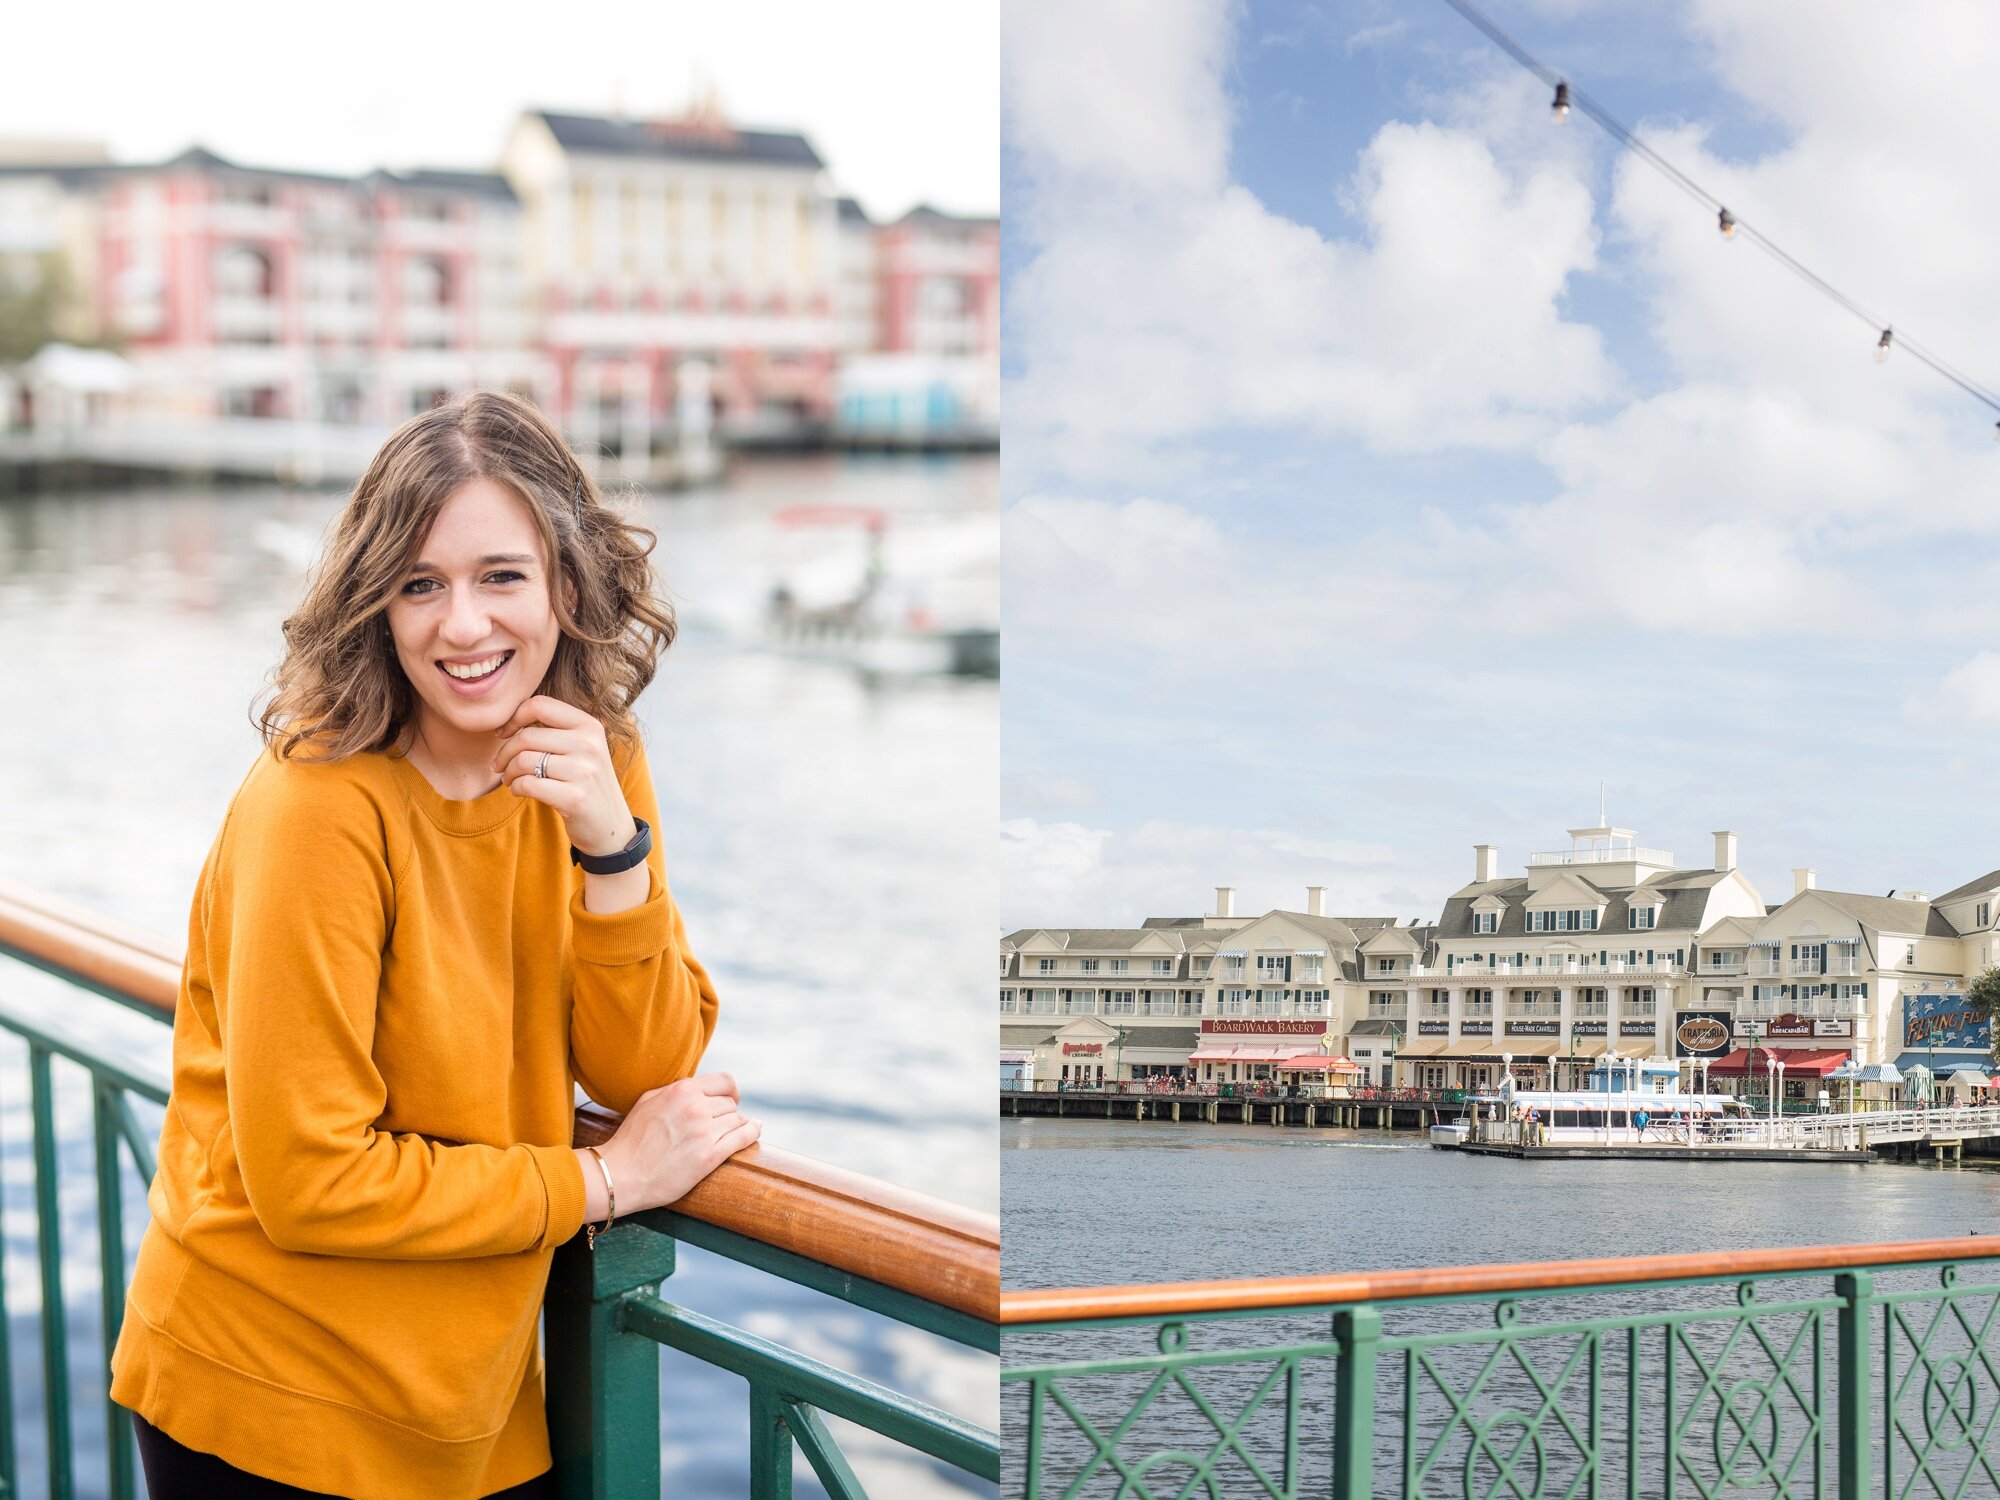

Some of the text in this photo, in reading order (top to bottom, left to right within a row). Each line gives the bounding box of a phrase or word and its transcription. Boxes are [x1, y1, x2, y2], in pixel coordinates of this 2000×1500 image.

[1212, 1022, 1316, 1033] BOARDWALK BAKERY
[1511, 1025, 1536, 1033] HOUSE-MADE
[1574, 1025, 1585, 1033] SUPER
[1585, 1025, 1598, 1033] TUSCAN
[1906, 1011, 1959, 1047] FLYING
[1683, 1028, 1724, 1038] TRATTORIA
